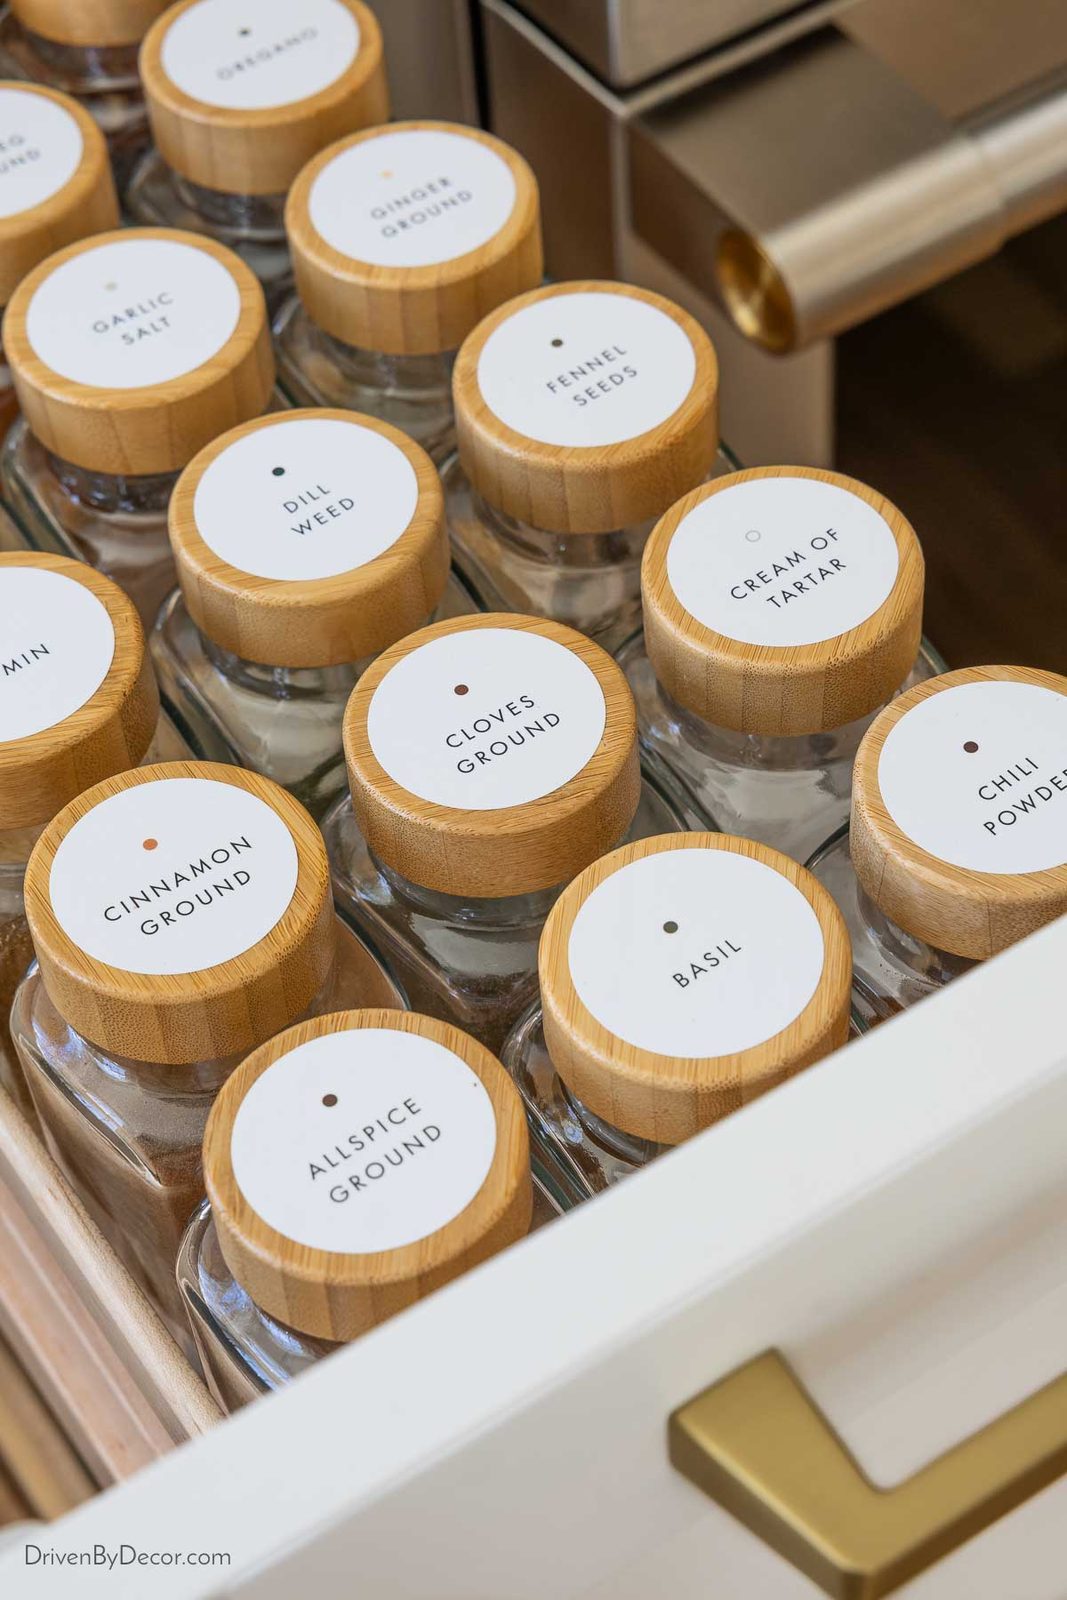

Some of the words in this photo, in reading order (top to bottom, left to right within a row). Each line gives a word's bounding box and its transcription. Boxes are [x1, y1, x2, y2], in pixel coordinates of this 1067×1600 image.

[217, 27, 318, 80] OREGANO
[371, 176, 452, 219] GINGER
[381, 190, 473, 238] GROUND
[92, 292, 173, 333] GARLIC
[121, 317, 171, 345] SALT
[546, 345, 627, 394] FENNEL
[573, 366, 638, 407] SEEDS
[283, 485, 331, 514] DILL
[291, 498, 355, 536] WEED
[731, 551, 806, 600] CREAM
[811, 528, 839, 551] OF
[766, 559, 847, 608] TARTAR
[446, 696, 535, 748] CLOVES
[457, 713, 560, 773] GROUND
[979, 758, 1039, 800] CHILI
[983, 769, 1067, 836] POWDE
[104, 836, 252, 921] CINNAMON
[141, 871, 250, 935] GROUND
[672, 940, 742, 988] BASIL
[309, 1098, 421, 1181] ALLSPICE
[330, 1125, 441, 1203] GROUND
